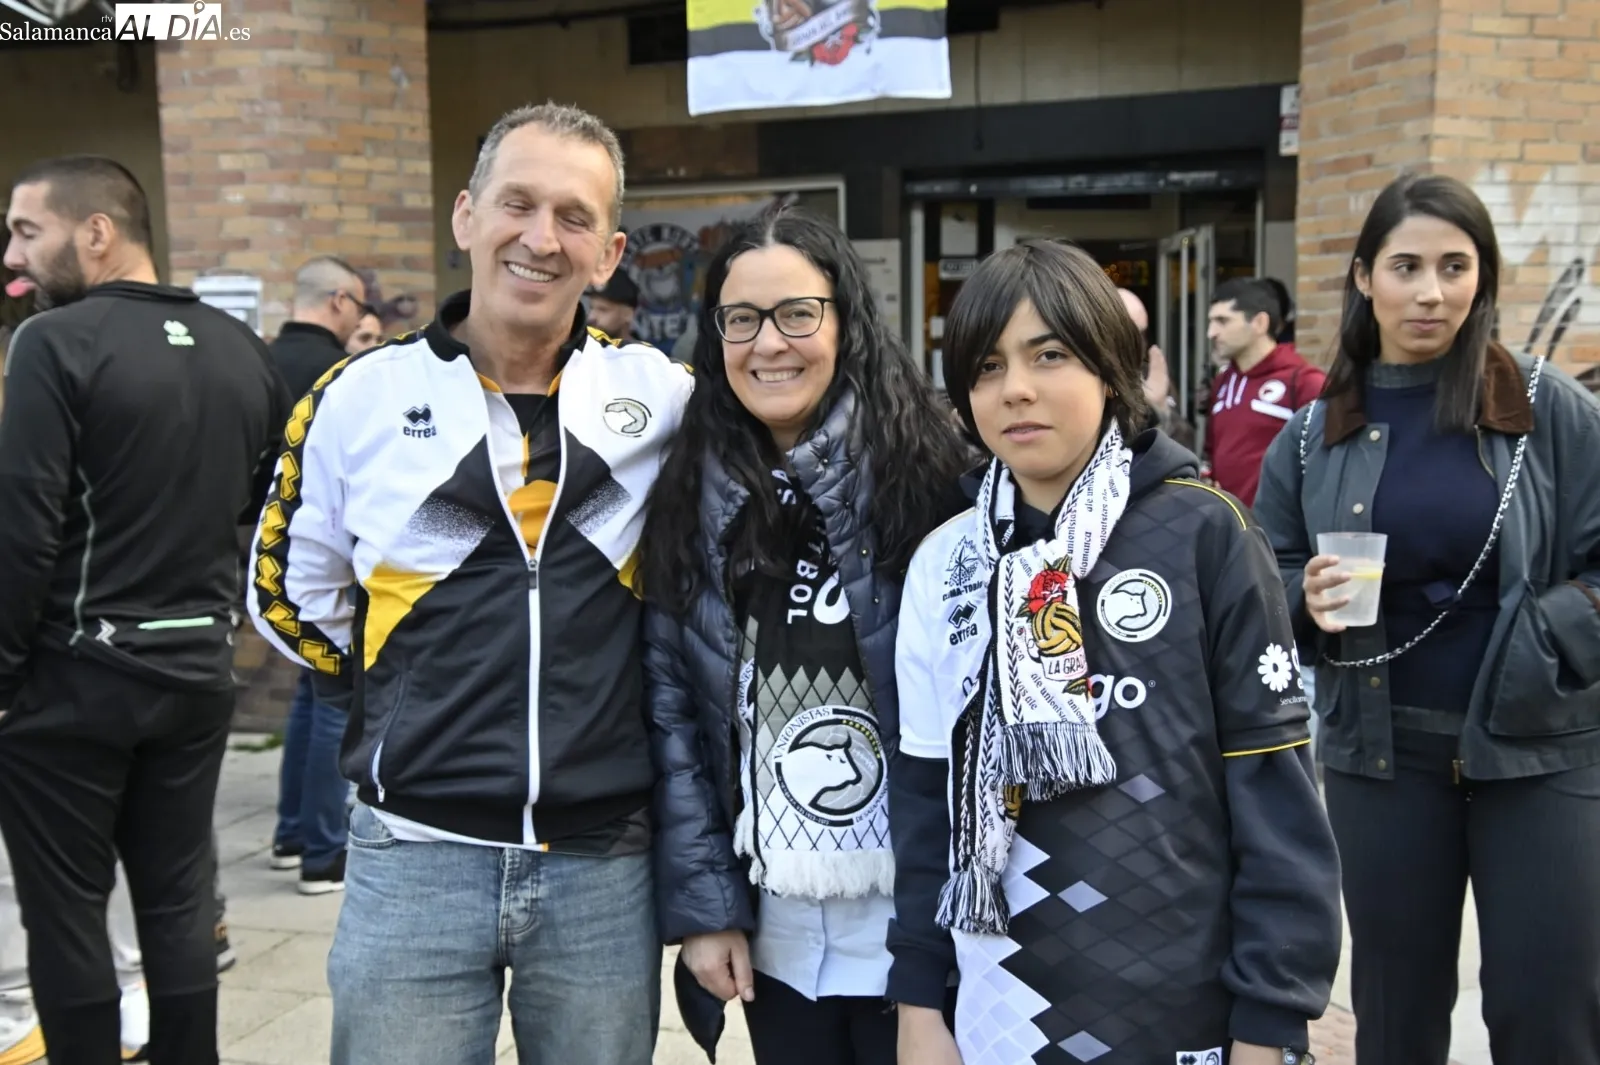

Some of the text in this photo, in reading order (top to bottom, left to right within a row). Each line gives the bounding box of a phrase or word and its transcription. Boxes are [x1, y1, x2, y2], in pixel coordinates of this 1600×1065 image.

[1048, 661, 1061, 675] LA
[1031, 673, 1043, 688] ale
[1026, 696, 1037, 710] ale
